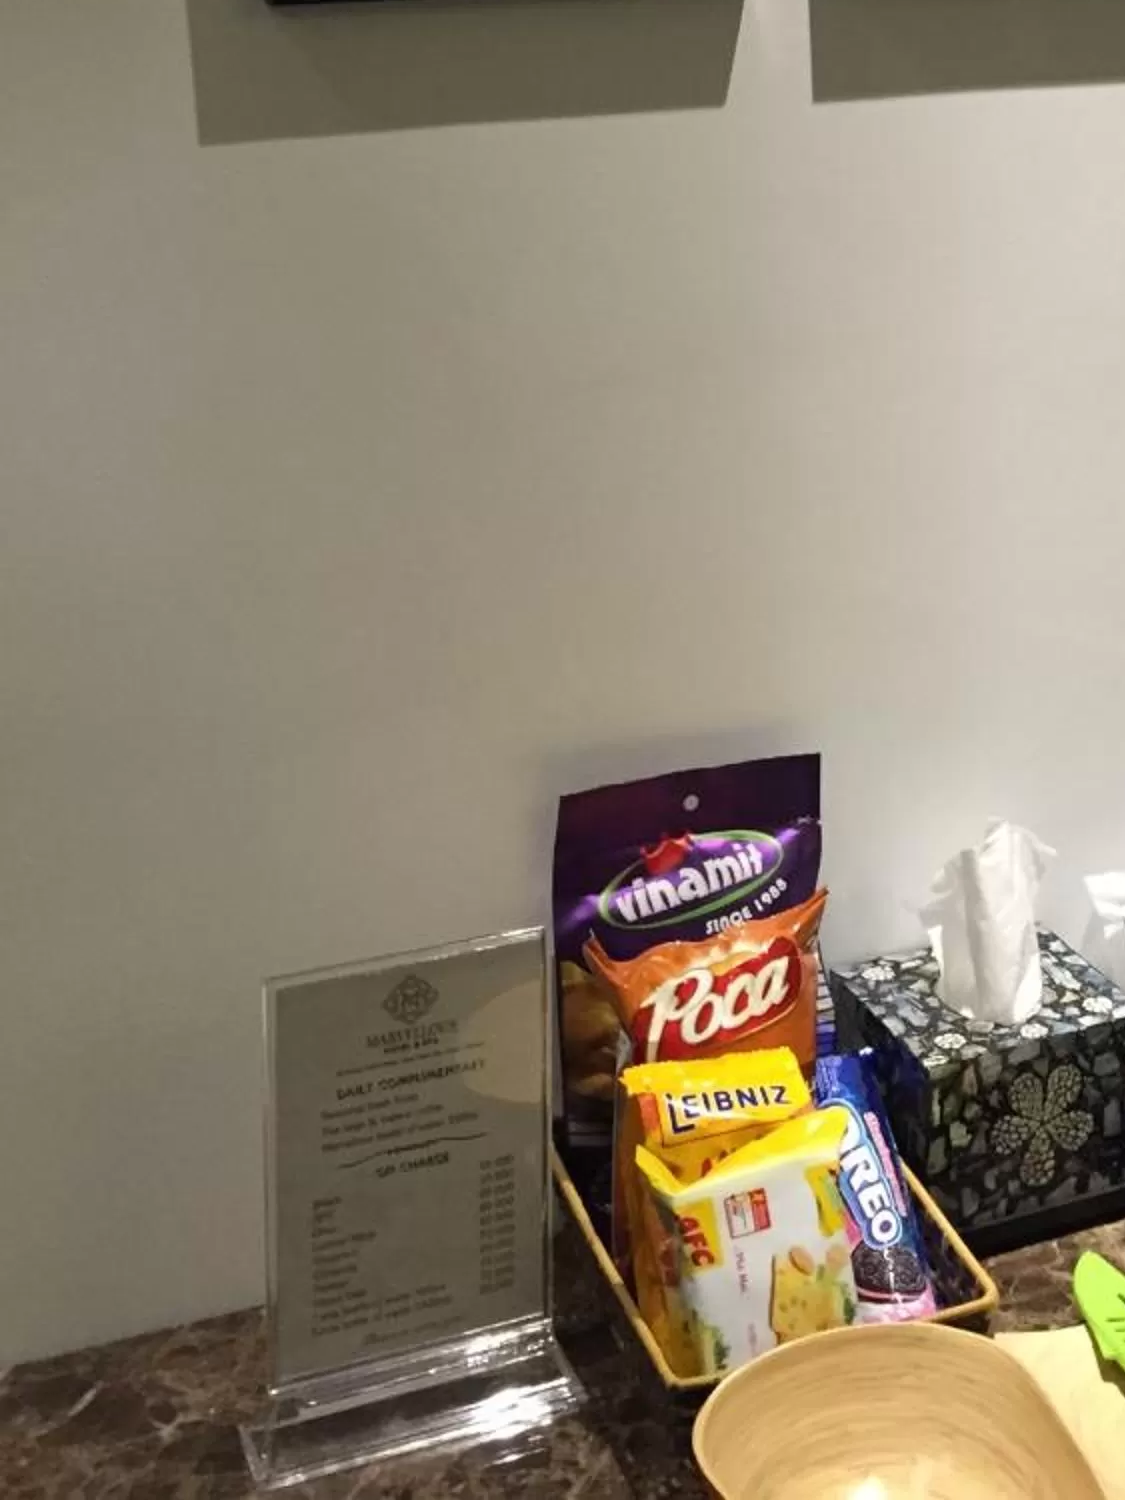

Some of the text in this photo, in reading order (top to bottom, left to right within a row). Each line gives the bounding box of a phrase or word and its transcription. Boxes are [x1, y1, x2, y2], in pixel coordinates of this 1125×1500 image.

[615, 839, 764, 923] vinamit
[640, 955, 791, 1063] Poca
[665, 1084, 792, 1134] LEIBNIZ
